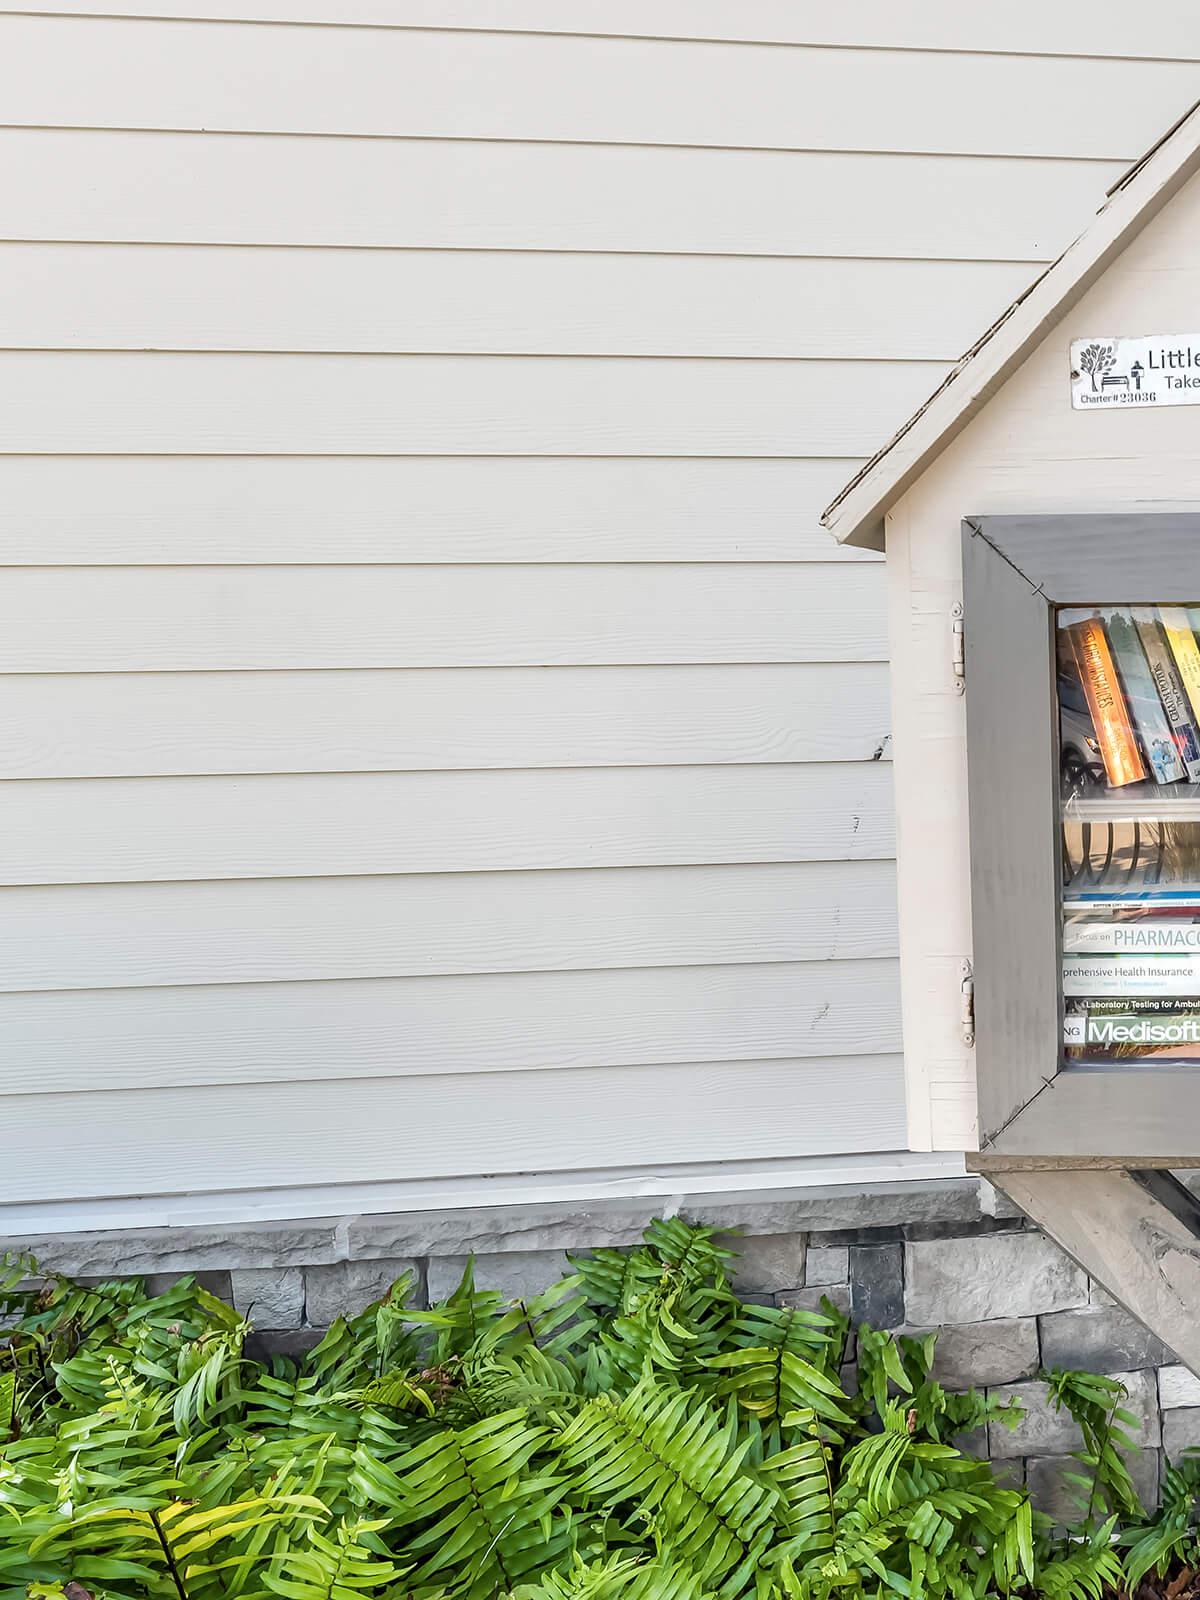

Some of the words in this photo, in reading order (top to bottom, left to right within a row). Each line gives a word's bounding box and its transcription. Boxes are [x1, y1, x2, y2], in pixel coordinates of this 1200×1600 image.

[1164, 375, 1200, 389] Take
[1082, 642, 1114, 708] CIRCUMSTANCES
[1161, 690, 1181, 722] CHAIM
[1114, 968, 1146, 977] Health
[1148, 968, 1193, 977] Insurance
[1086, 1000, 1130, 1009] Laboratory
[1132, 1000, 1160, 1009] Testing
[1161, 1000, 1172, 1008] for
[1088, 1021, 1200, 1042] Medisoft
